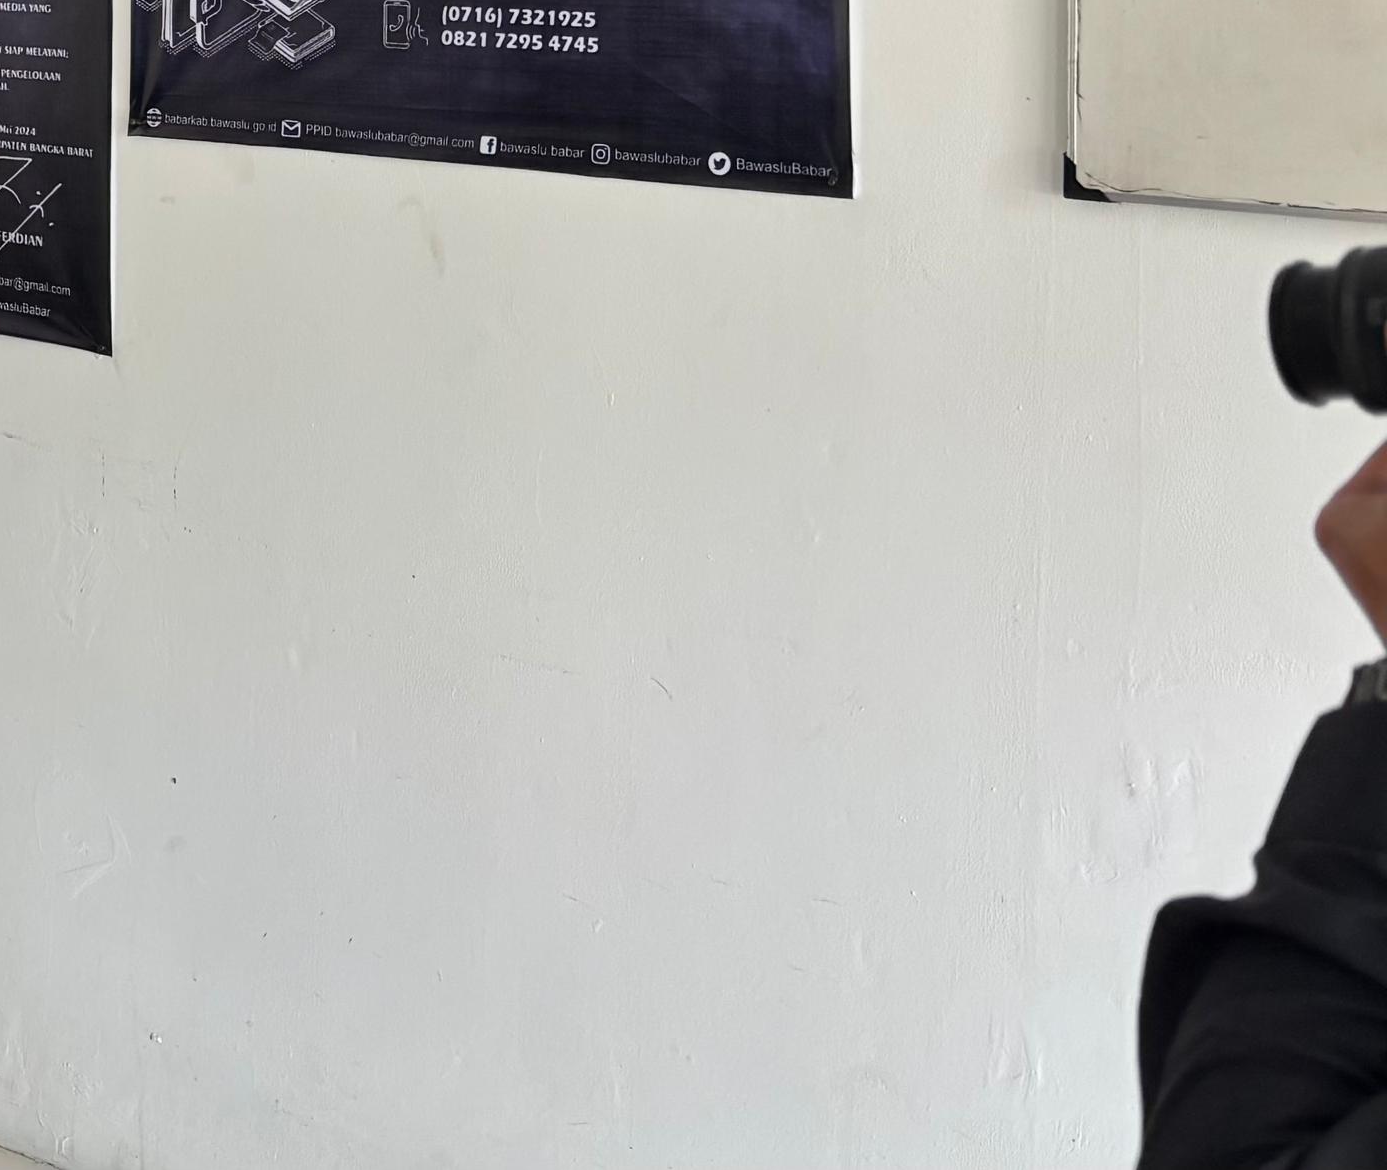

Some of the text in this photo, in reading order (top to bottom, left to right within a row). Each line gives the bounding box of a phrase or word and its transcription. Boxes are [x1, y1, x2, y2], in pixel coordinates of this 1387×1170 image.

[442, 5, 595, 27] (0716) 7321925
[441, 29, 598, 52] 0821 7295 4745
